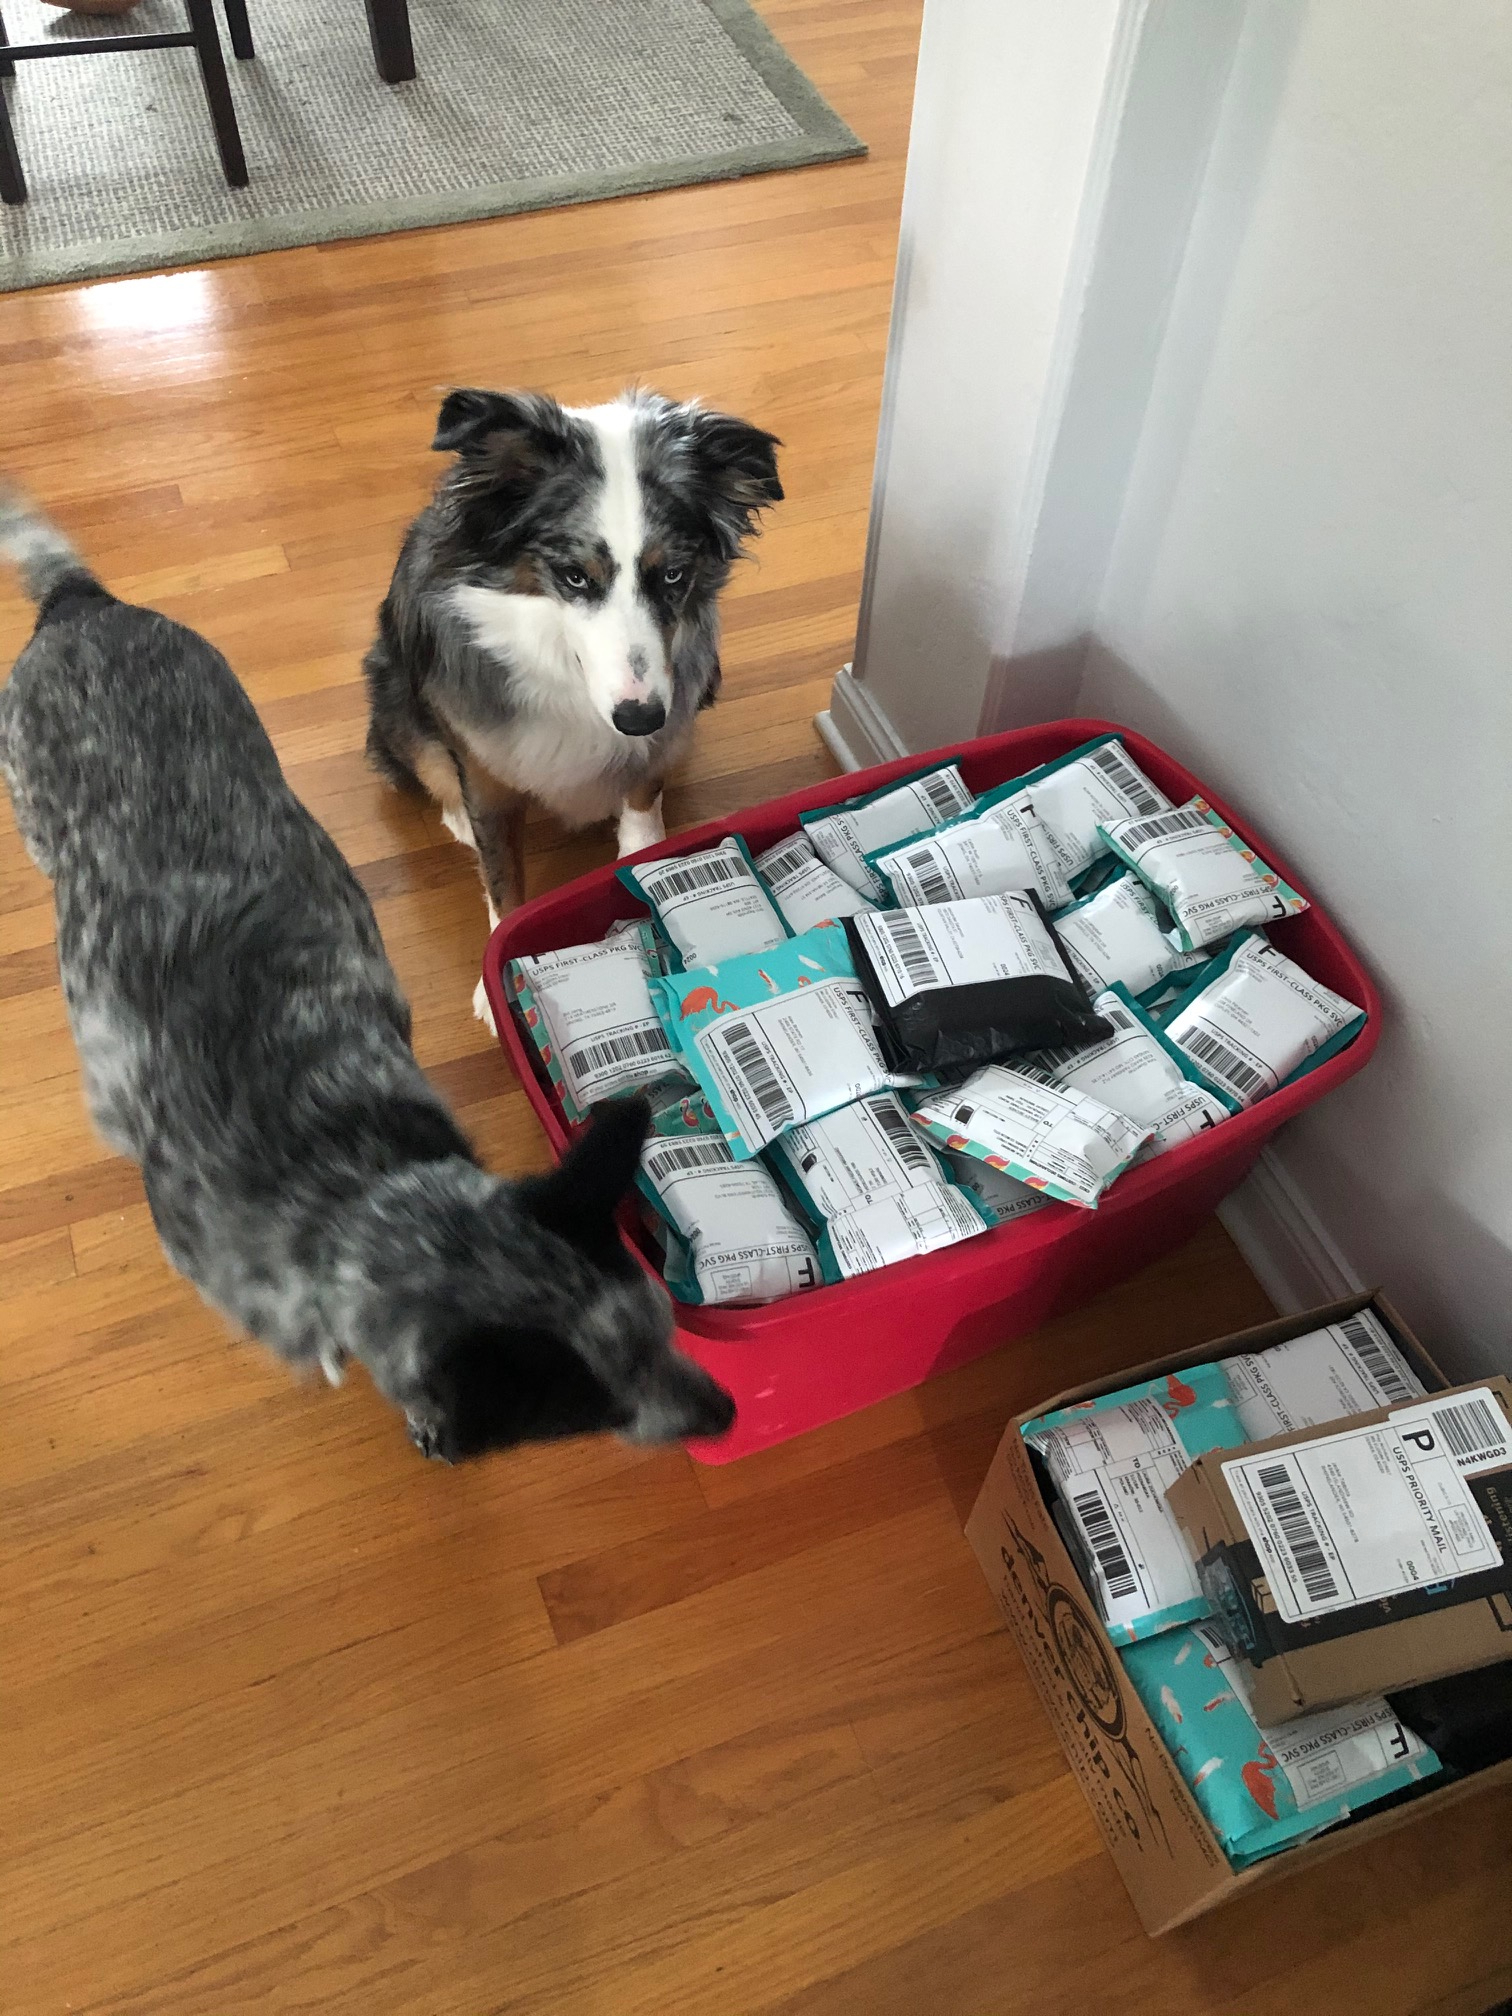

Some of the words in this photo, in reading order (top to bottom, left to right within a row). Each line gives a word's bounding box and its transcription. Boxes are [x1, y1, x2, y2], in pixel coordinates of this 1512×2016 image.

[839, 824, 853, 841] PKG
[1006, 808, 1023, 828] USPS
[1018, 826, 1044, 875] FIRST-CLASS
[1039, 874, 1051, 893] PKG
[1045, 892, 1057, 908] SVC
[1056, 847, 1074, 867] USPS
[798, 866, 810, 876] USPS
[696, 884, 721, 896] TRACKING
[722, 880, 735, 889] USPS
[777, 873, 798, 889] TRACKING
[942, 865, 952, 878] USPS
[947, 878, 961, 901] TRACKIN
[1010, 895, 1033, 911] F
[1198, 900, 1214, 912] PKG
[1214, 888, 1259, 906] FIRST-CLASS
[1181, 906, 1198, 917] SVC
[1272, 896, 1287, 918] F
[1002, 905, 1029, 944] FIRST-CLASS
[1023, 943, 1035, 957] PKG
[1029, 957, 1041, 971] SVC
[531, 962, 555, 976] USPS
[555, 948, 608, 969] FIRST-CLASS
[609, 944, 626, 954] PKG
[1181, 951, 1192, 963] VC
[846, 991, 869, 1004] F
[1245, 950, 1268, 968] USPS
[1266, 963, 1314, 1002] FIRST-CLASS
[1312, 998, 1330, 1014] PKG
[1328, 1010, 1343, 1028] SVC
[590, 1033, 604, 1042] USPS
[605, 1025, 634, 1037] TRACKING
[832, 985, 850, 1006] USPS
[844, 1004, 876, 1053] FIRST-CLASS
[871, 1051, 886, 1069] PKG
[1106, 1036, 1120, 1047] USPS
[1210, 1027, 1224, 1040] USPS
[1223, 1037, 1249, 1058] TRACKING
[1254, 1061, 1263, 1070] EP
[760, 1040, 771, 1053] USPS
[767, 1053, 785, 1079] TRACKING
[1080, 1043, 1107, 1062] TRACKING
[608, 1065, 622, 1074] 1202
[633, 1068, 648, 1078] shop
[728, 1088, 740, 1103] shop
[1183, 1094, 1206, 1113] USPS
[1042, 1119, 1053, 1127] TO
[1150, 1106, 1185, 1132] FIRST-C
[864, 1194, 873, 1204] TO
[1015, 1191, 1050, 1210] T-CLASS
[996, 1203, 1015, 1216] PKG
[717, 1253, 736, 1264] PKG
[737, 1243, 789, 1260] FIRST-CLASS
[697, 1257, 716, 1269] SVC
[798, 1257, 815, 1288] F
[1249, 1366, 1265, 1384] PKG
[1350, 1355, 1371, 1381] TRACKING
[1259, 1382, 1295, 1432] FIRST-CLASS
[1402, 1429, 1435, 1452] P
[1132, 1457, 1141, 1469] TO
[1456, 1445, 1506, 1467] N4KWGD3
[1390, 1444, 1412, 1473] USPS
[1404, 1472, 1436, 1524] PRIORITY
[1428, 1523, 1449, 1554] MAIL
[1255, 1490, 1266, 1507] 9305
[1262, 1506, 1274, 1523] 5202
[1269, 1523, 1280, 1540] 0760
[1275, 1539, 1287, 1556] 0223
[1300, 1490, 1313, 1507] USPS
[1308, 1508, 1328, 1542] TRACKING
[1327, 1551, 1336, 1561] EP
[1260, 1535, 1273, 1554] shop
[1405, 1559, 1420, 1581] 0004
[995, 1544, 1068, 1684] denver
[1061, 1688, 1113, 1781] chip
[1109, 1786, 1147, 1853] co.
[1319, 1714, 1375, 1745] FIRST-CLASS
[1298, 1738, 1319, 1754] PKG
[1390, 1723, 1409, 1759] F
[1280, 1747, 1299, 1762] SVC
